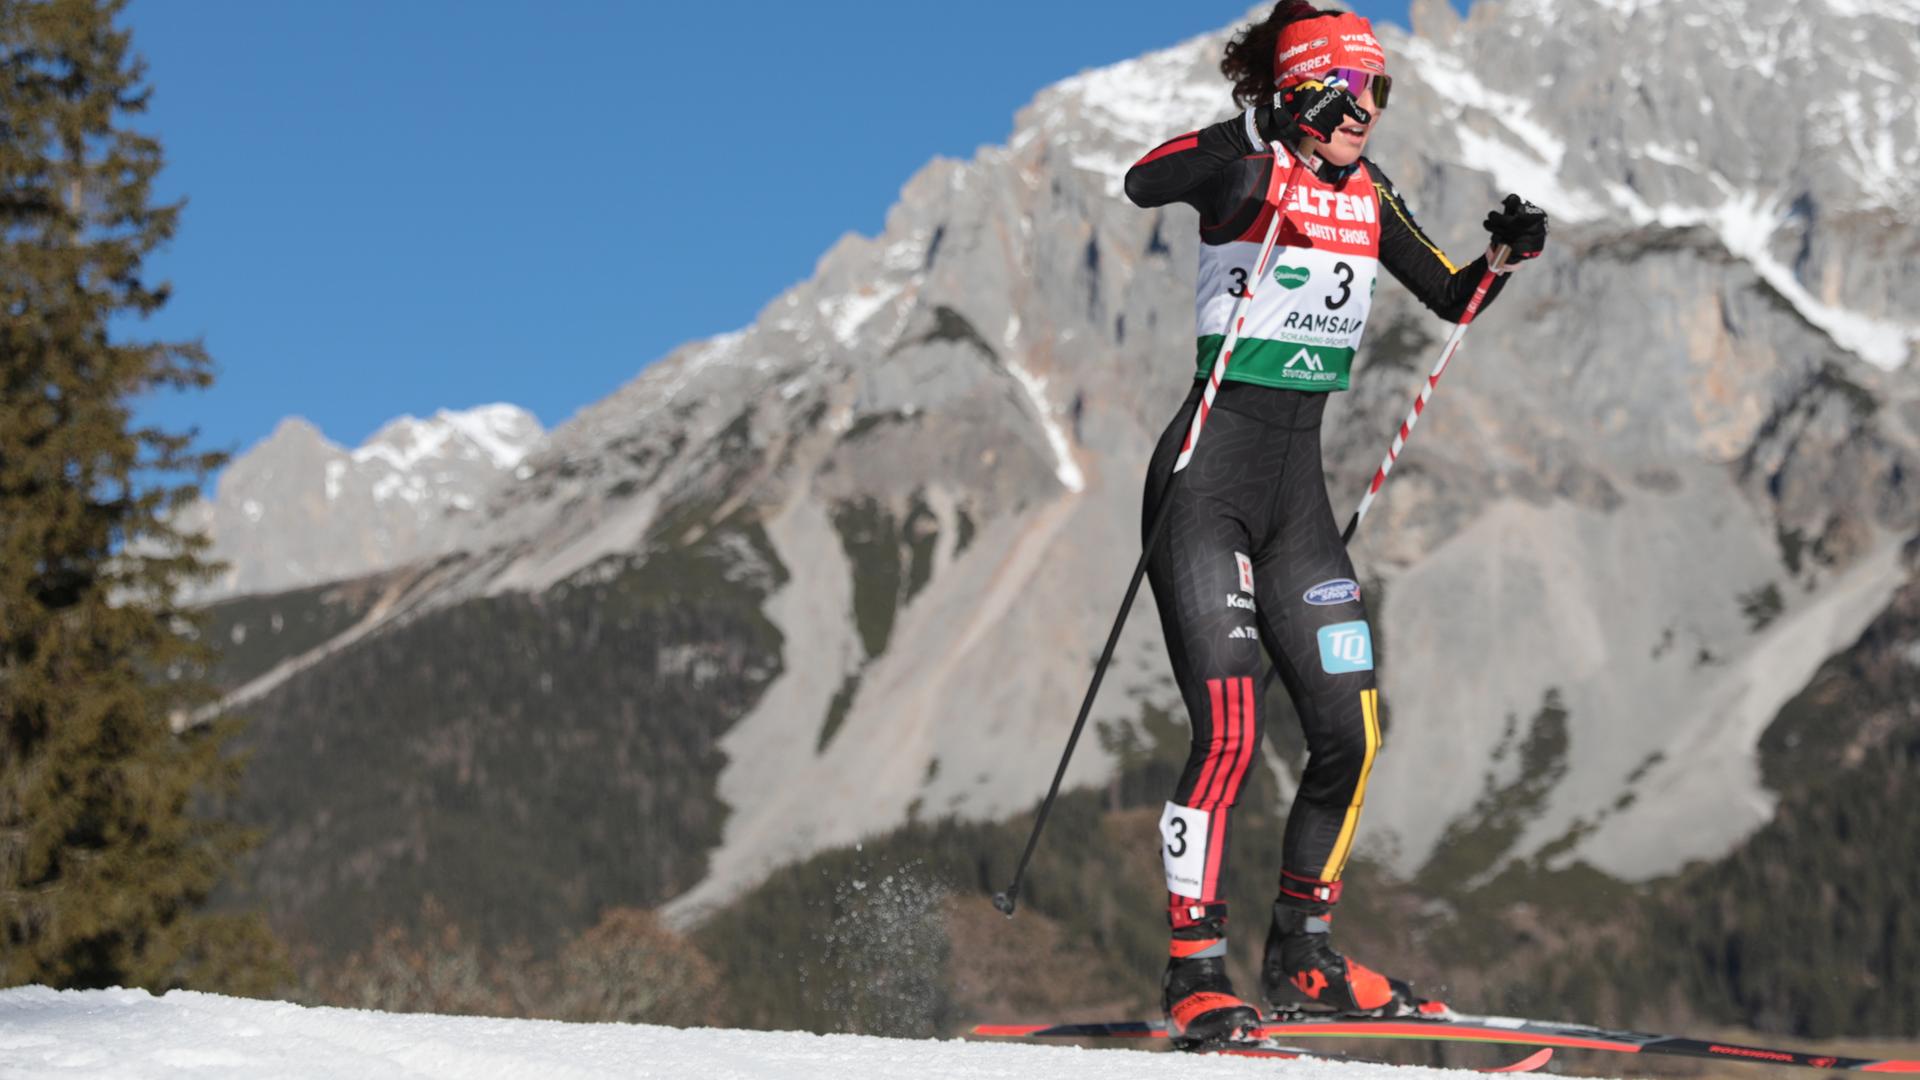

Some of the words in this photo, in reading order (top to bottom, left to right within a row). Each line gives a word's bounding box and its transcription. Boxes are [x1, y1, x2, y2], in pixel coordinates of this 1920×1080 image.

[1304, 221, 1337, 241] SAFETY
[1339, 228, 1370, 245] SHOES
[1228, 267, 1248, 297] 3
[1325, 261, 1354, 310] 3
[1328, 629, 1367, 664] TQ
[1168, 817, 1187, 857] 3
